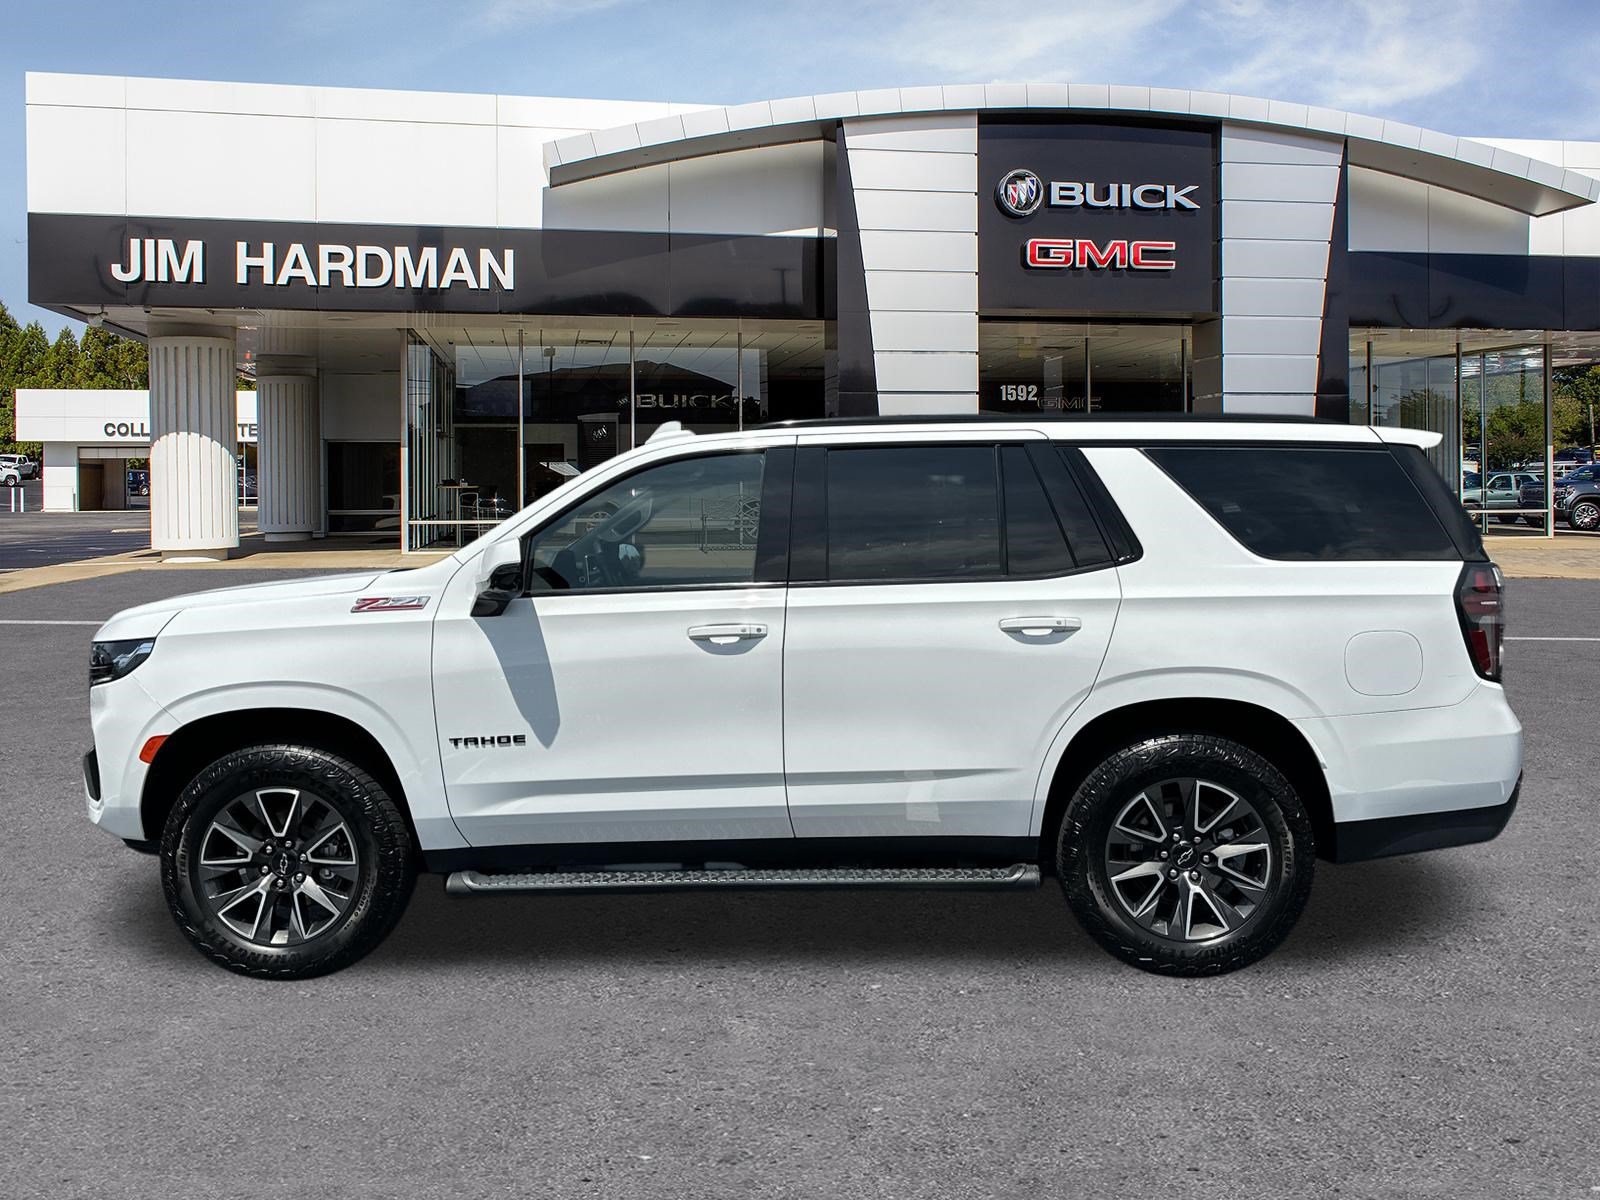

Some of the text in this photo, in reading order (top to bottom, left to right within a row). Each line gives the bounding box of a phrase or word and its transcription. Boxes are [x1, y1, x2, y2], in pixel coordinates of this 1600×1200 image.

[1049, 181, 1201, 210] BUICK
[110, 237, 515, 291] JIM HARDMAN
[1026, 238, 1176, 270] GMC
[635, 393, 732, 409] BUICK
[999, 384, 1038, 401] 1592
[448, 734, 527, 748] TAHOE
